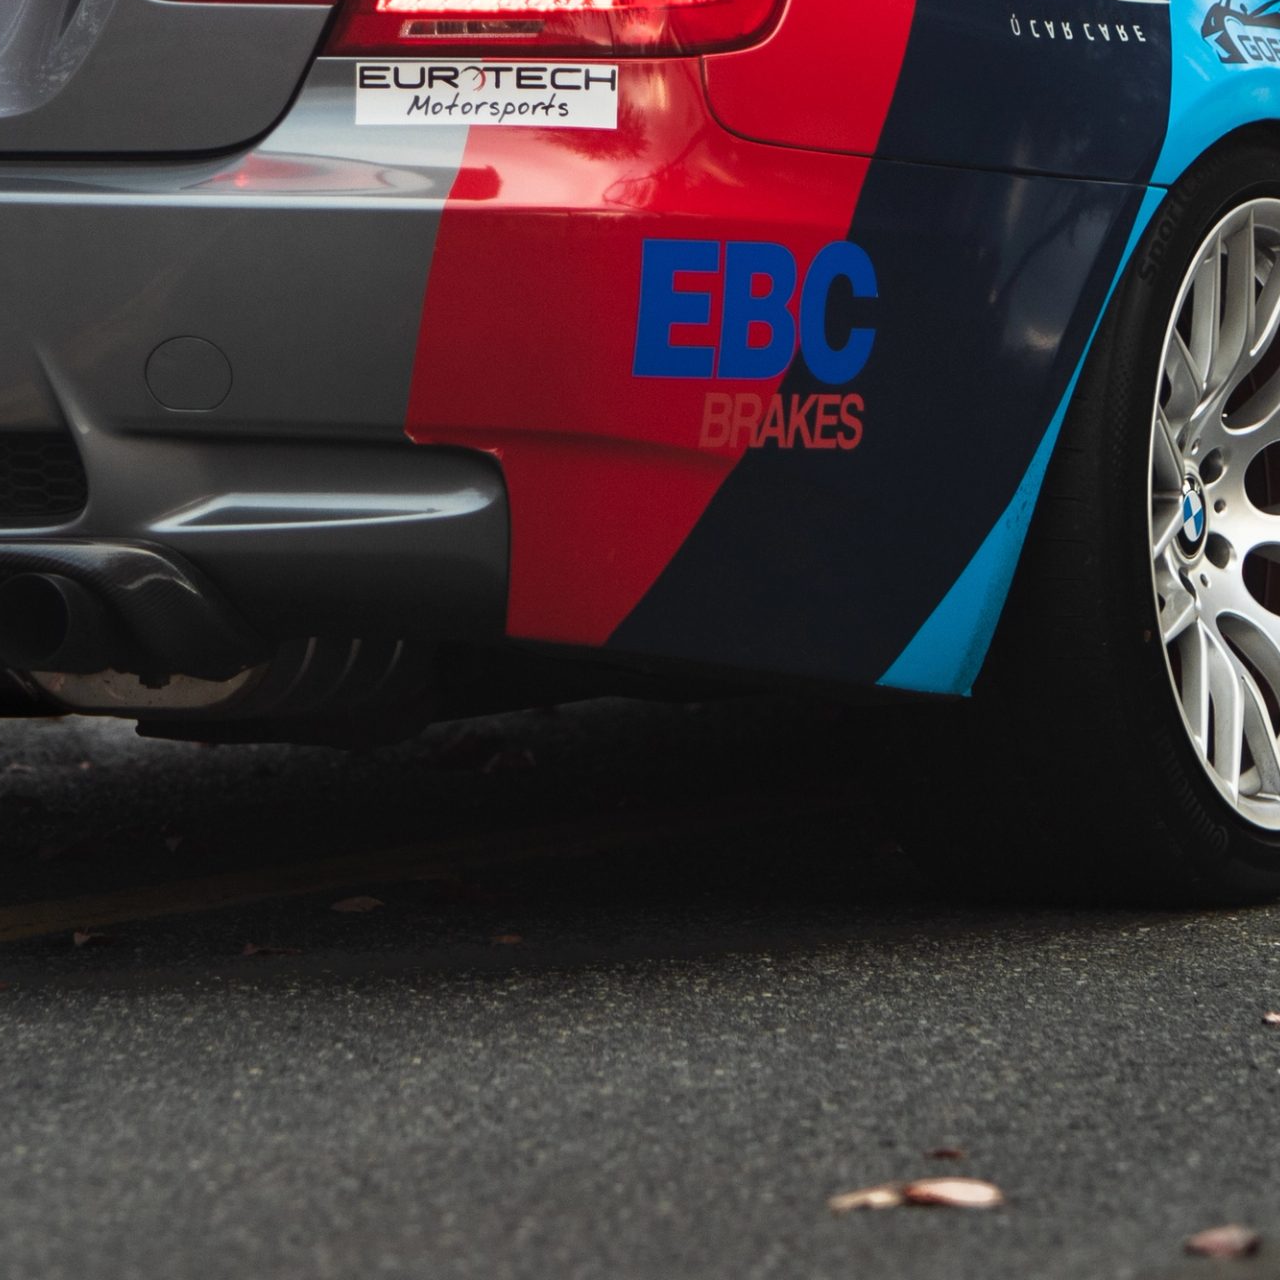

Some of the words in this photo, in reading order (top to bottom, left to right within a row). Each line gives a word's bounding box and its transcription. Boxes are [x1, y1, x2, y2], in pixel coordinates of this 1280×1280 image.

[407, 91, 570, 124] Motorsports
[631, 237, 879, 386] EBC
[697, 392, 865, 451] BRAKES
